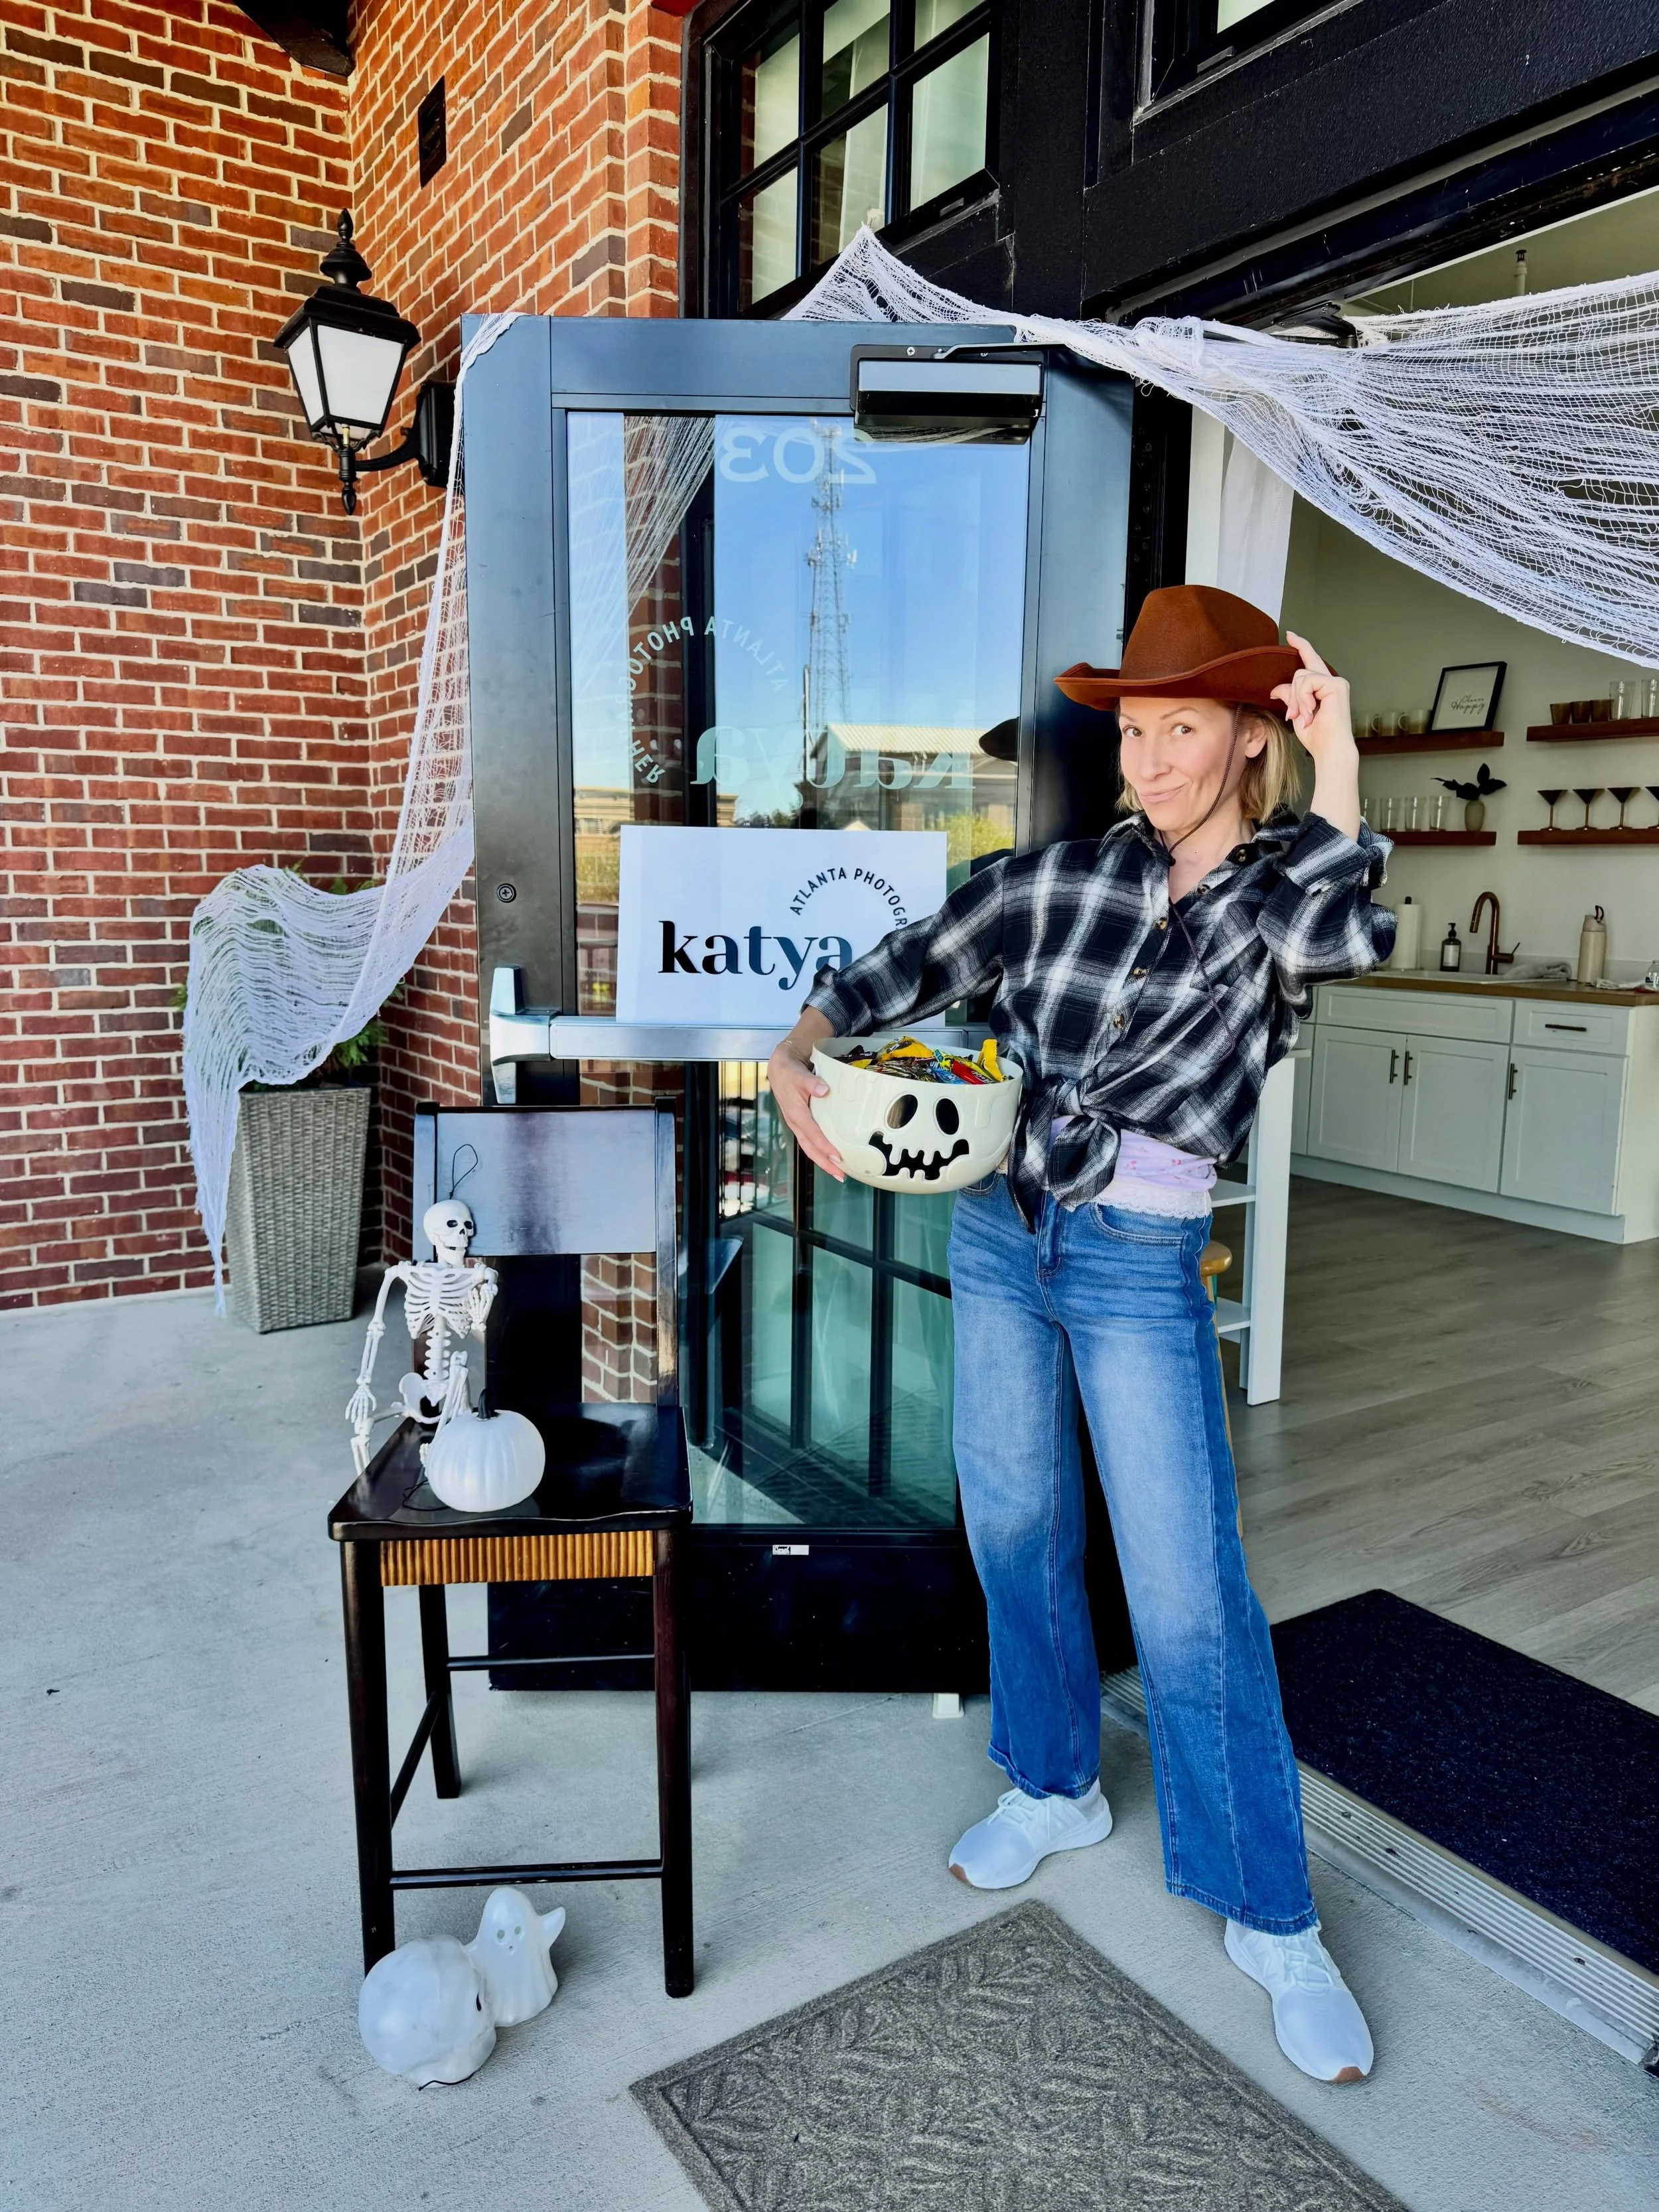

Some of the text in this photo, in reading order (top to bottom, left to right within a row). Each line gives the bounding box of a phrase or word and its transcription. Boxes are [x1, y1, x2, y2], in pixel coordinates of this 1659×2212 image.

[790, 867, 908, 930] ATLANTA PHOTOGR
[658, 920, 853, 991] katya
